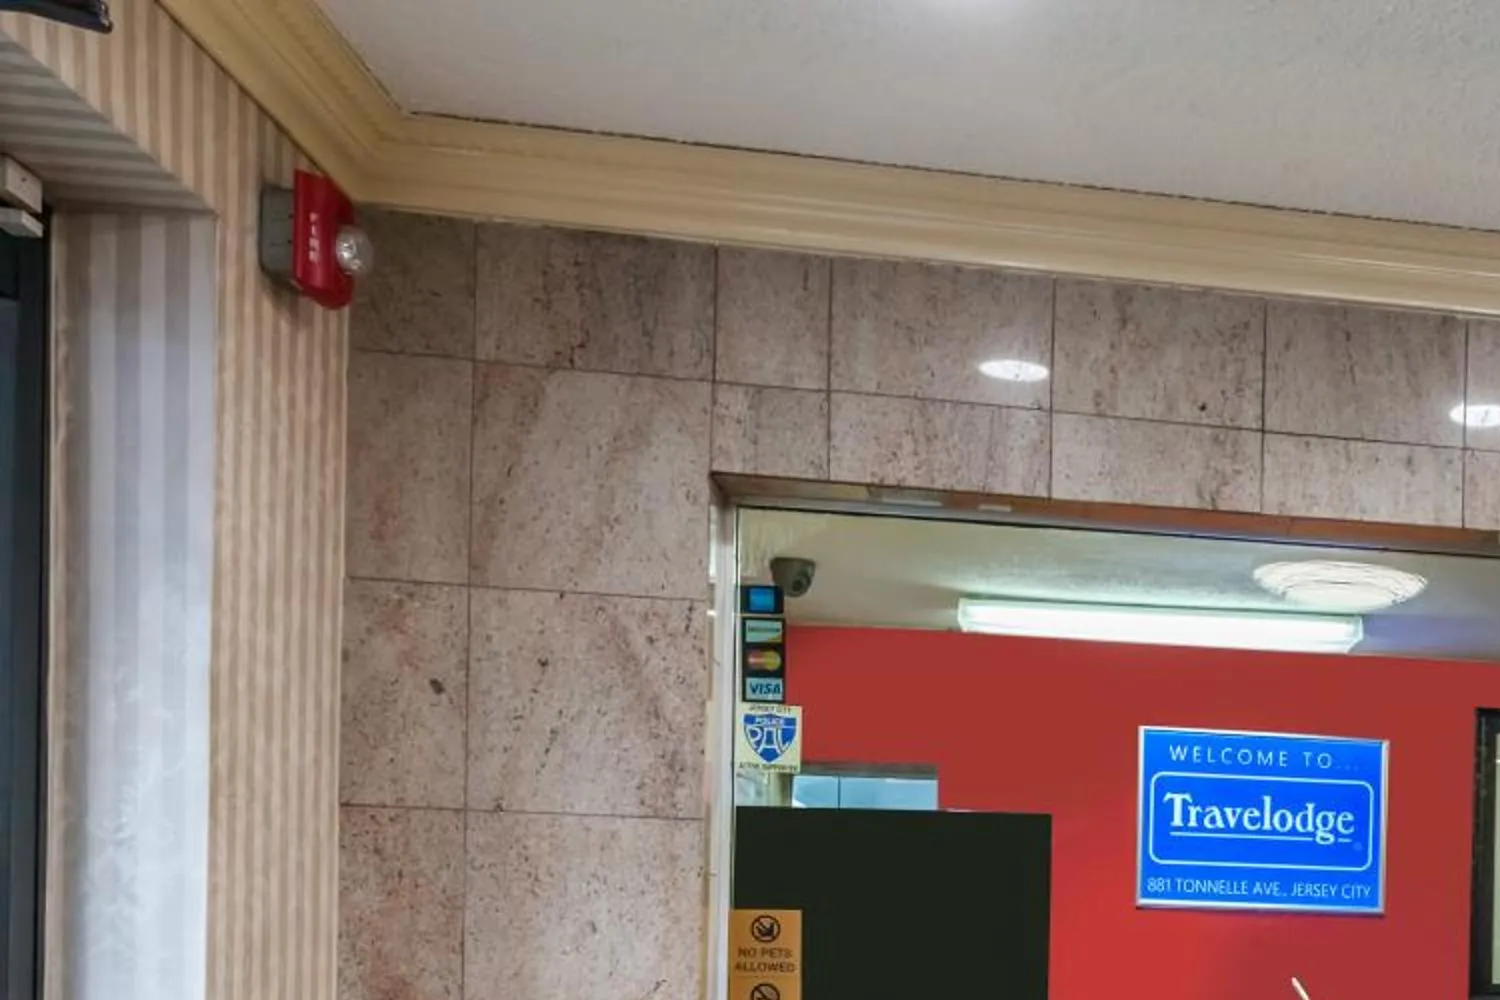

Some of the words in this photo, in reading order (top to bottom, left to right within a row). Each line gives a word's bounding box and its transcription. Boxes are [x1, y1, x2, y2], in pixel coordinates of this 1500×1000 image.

[749, 683, 782, 695] VISA
[1169, 744, 1288, 768] WELCOME
[1163, 792, 1355, 845] Travelodge
[1147, 877, 1171, 893] 881
[1175, 877, 1249, 896] TONNELLE
[1290, 881, 1338, 898] JERSEY
[1340, 884, 1372, 900] CITY
[738, 947, 757, 958] NO
[763, 948, 793, 959] PETS
[735, 961, 796, 973] ALLOWED
